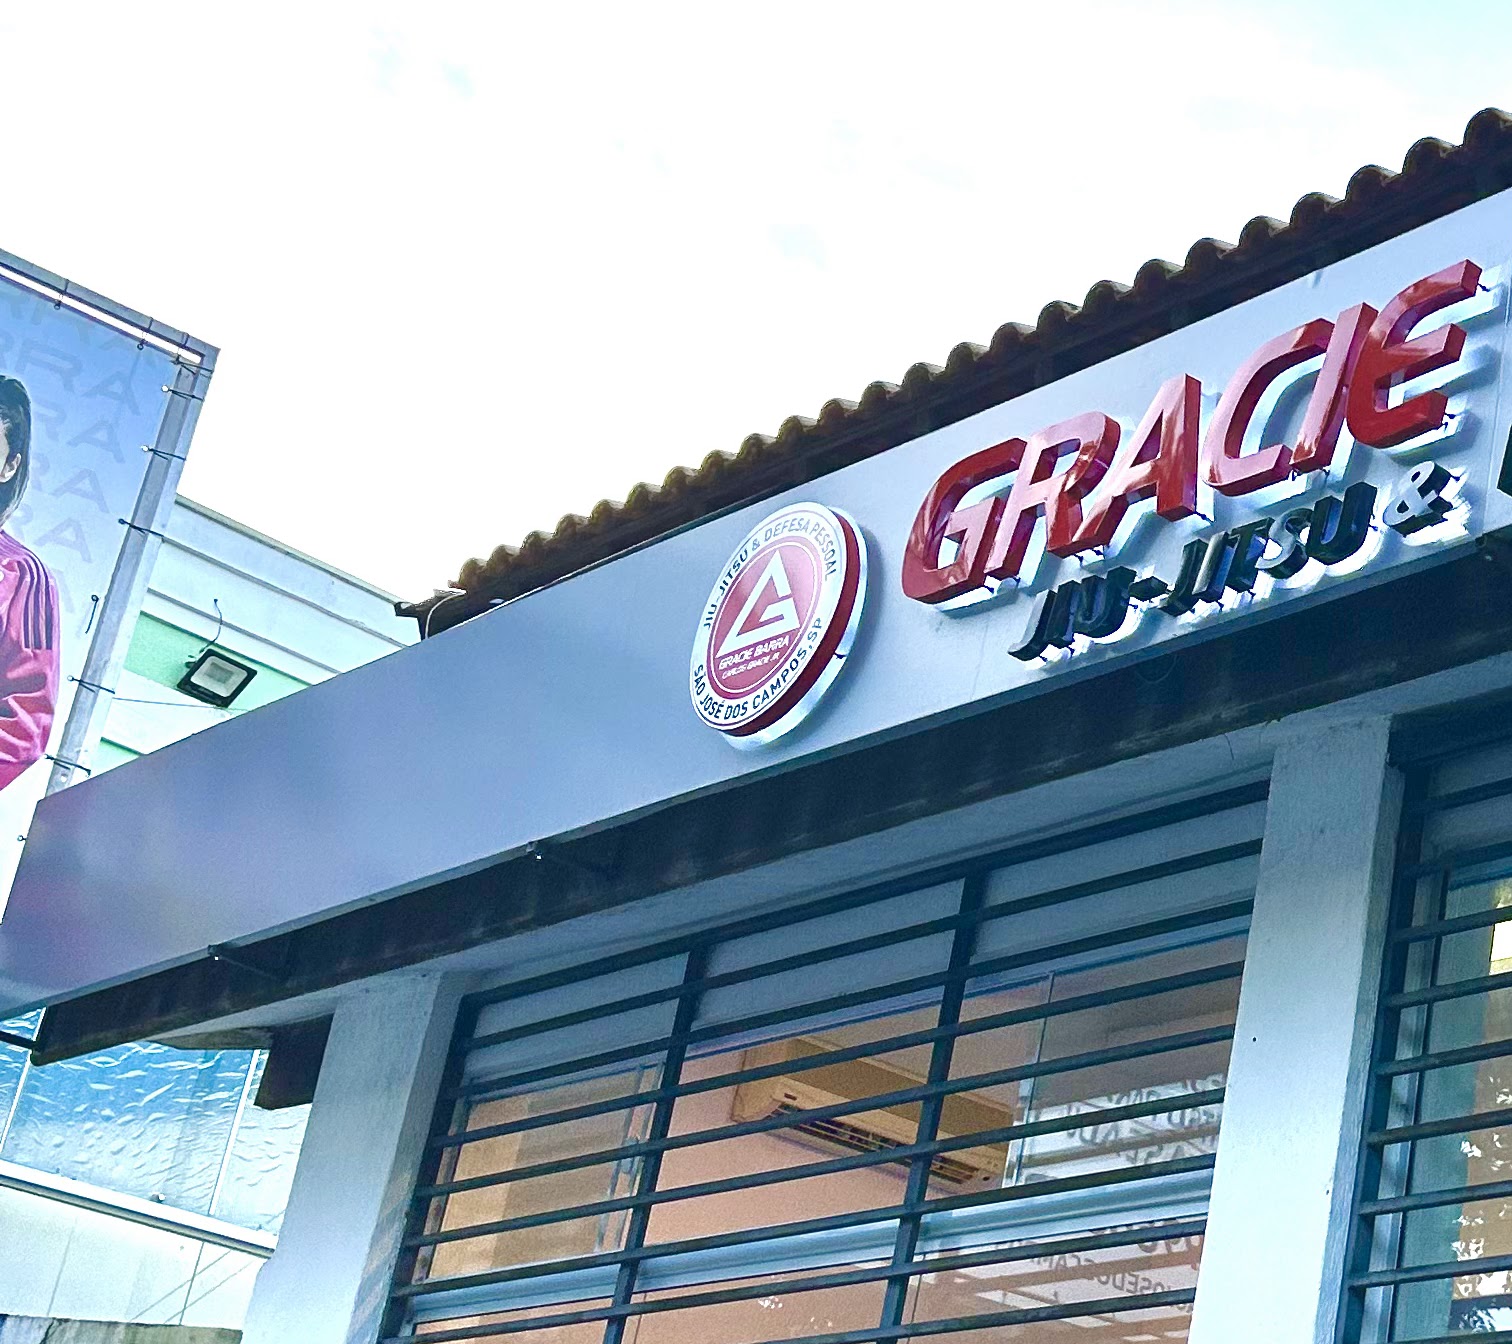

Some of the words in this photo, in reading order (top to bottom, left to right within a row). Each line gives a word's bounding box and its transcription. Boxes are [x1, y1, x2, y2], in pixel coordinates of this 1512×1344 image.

[902, 259, 1482, 603] GRACIE
[703, 548, 748, 631] JIU-JITSU
[764, 517, 811, 543] DEFESA
[808, 522, 837, 582] PESSOAL
[1007, 482, 1377, 660] JIU-JITSU
[1383, 460, 1452, 536] &
[700, 693, 724, 719] JOSÉ
[724, 701, 748, 720] DOS
